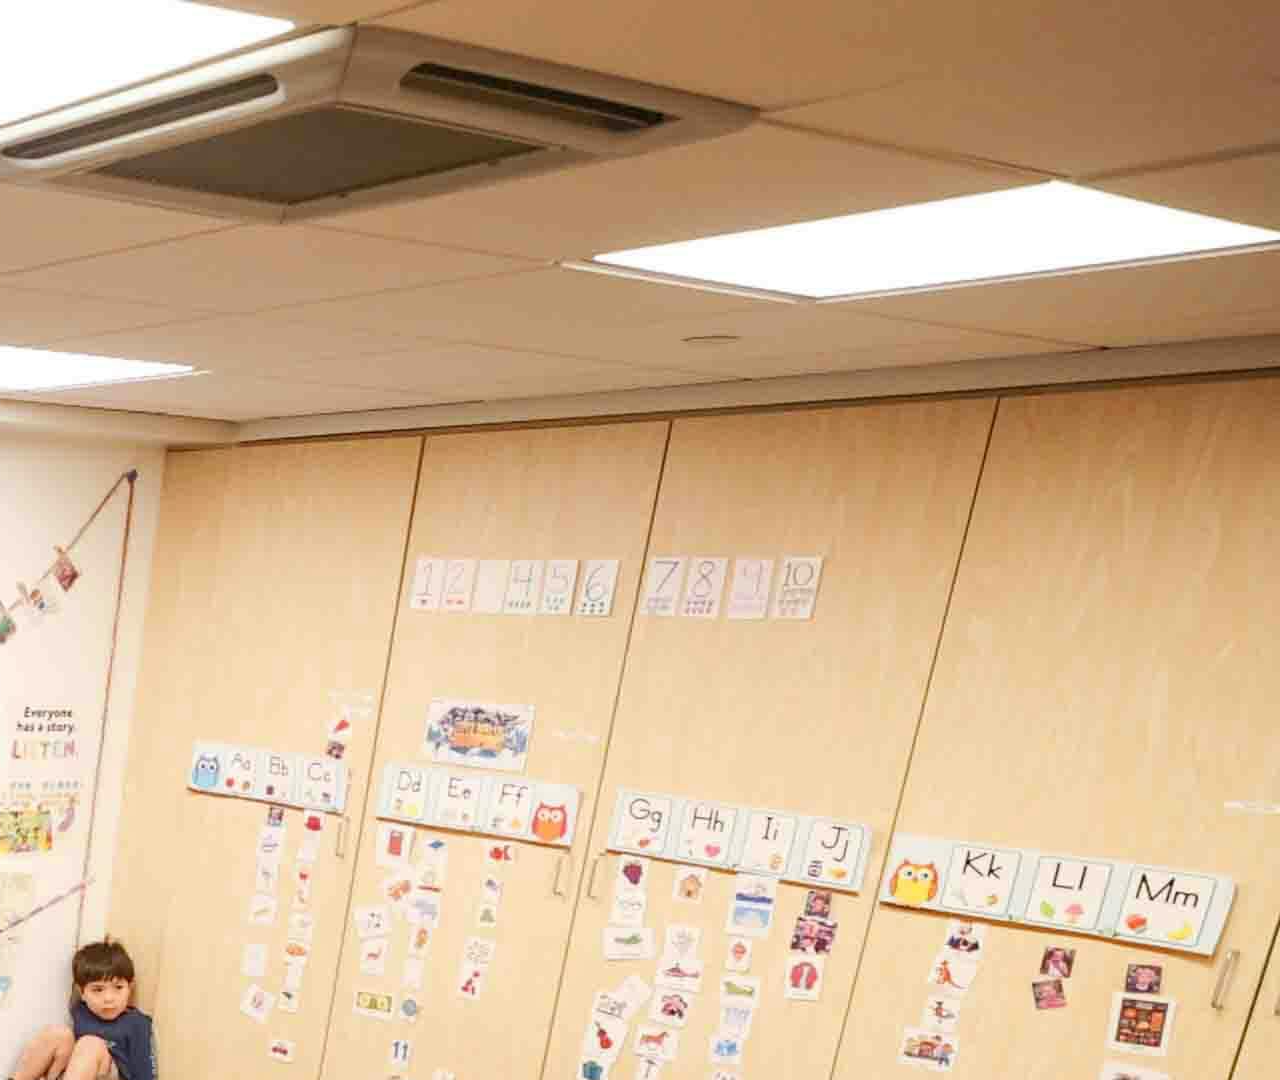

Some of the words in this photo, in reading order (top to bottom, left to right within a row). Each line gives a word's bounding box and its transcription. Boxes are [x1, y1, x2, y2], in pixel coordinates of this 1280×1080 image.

[586, 563, 609, 601] 6
[655, 560, 680, 592] 7
[691, 560, 715, 598] 8
[783, 561, 814, 587] 10
[16, 721, 35, 732] has
[23, 706, 72, 720] Everyone
[269, 756, 288, 776] Bb
[308, 762, 332, 783] Cc
[398, 770, 422, 792] Dd
[448, 777, 471, 799] Ee
[500, 784, 529, 806] Ff
[629, 798, 663, 833] Gg
[691, 807, 724, 832] Hh
[761, 816, 779, 841] Ii
[821, 826, 849, 863] Jj
[961, 849, 1004, 880] Kk
[1051, 862, 1088, 891] Ll
[1135, 873, 1199, 908] Mm
